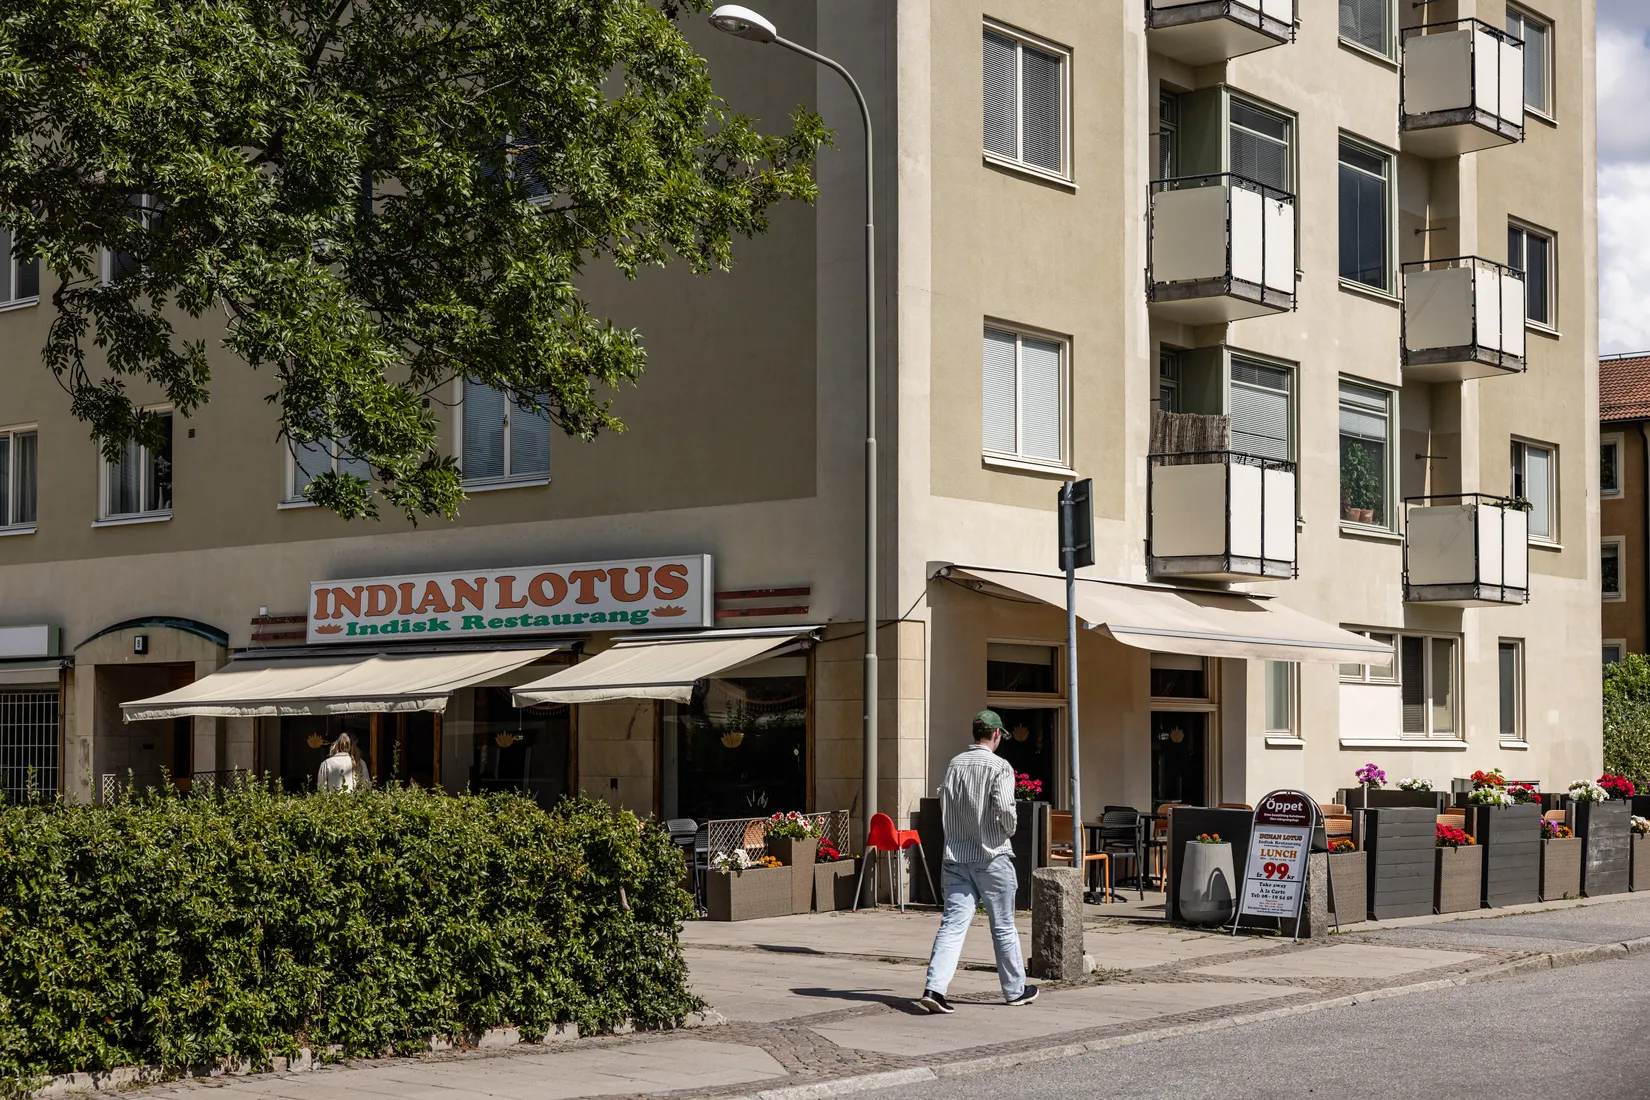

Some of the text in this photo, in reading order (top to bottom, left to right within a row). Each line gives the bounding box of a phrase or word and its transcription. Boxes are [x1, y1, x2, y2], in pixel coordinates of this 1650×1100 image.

[314, 564, 689, 620] INDIAN LOTUS
[346, 609, 649, 636] Indisk Restaurang
[1266, 797, 1303, 813] Öppet
[1259, 833, 1282, 841] INDIAN
[1260, 848, 1297, 859] LUNCH
[1263, 861, 1289, 880] 99
